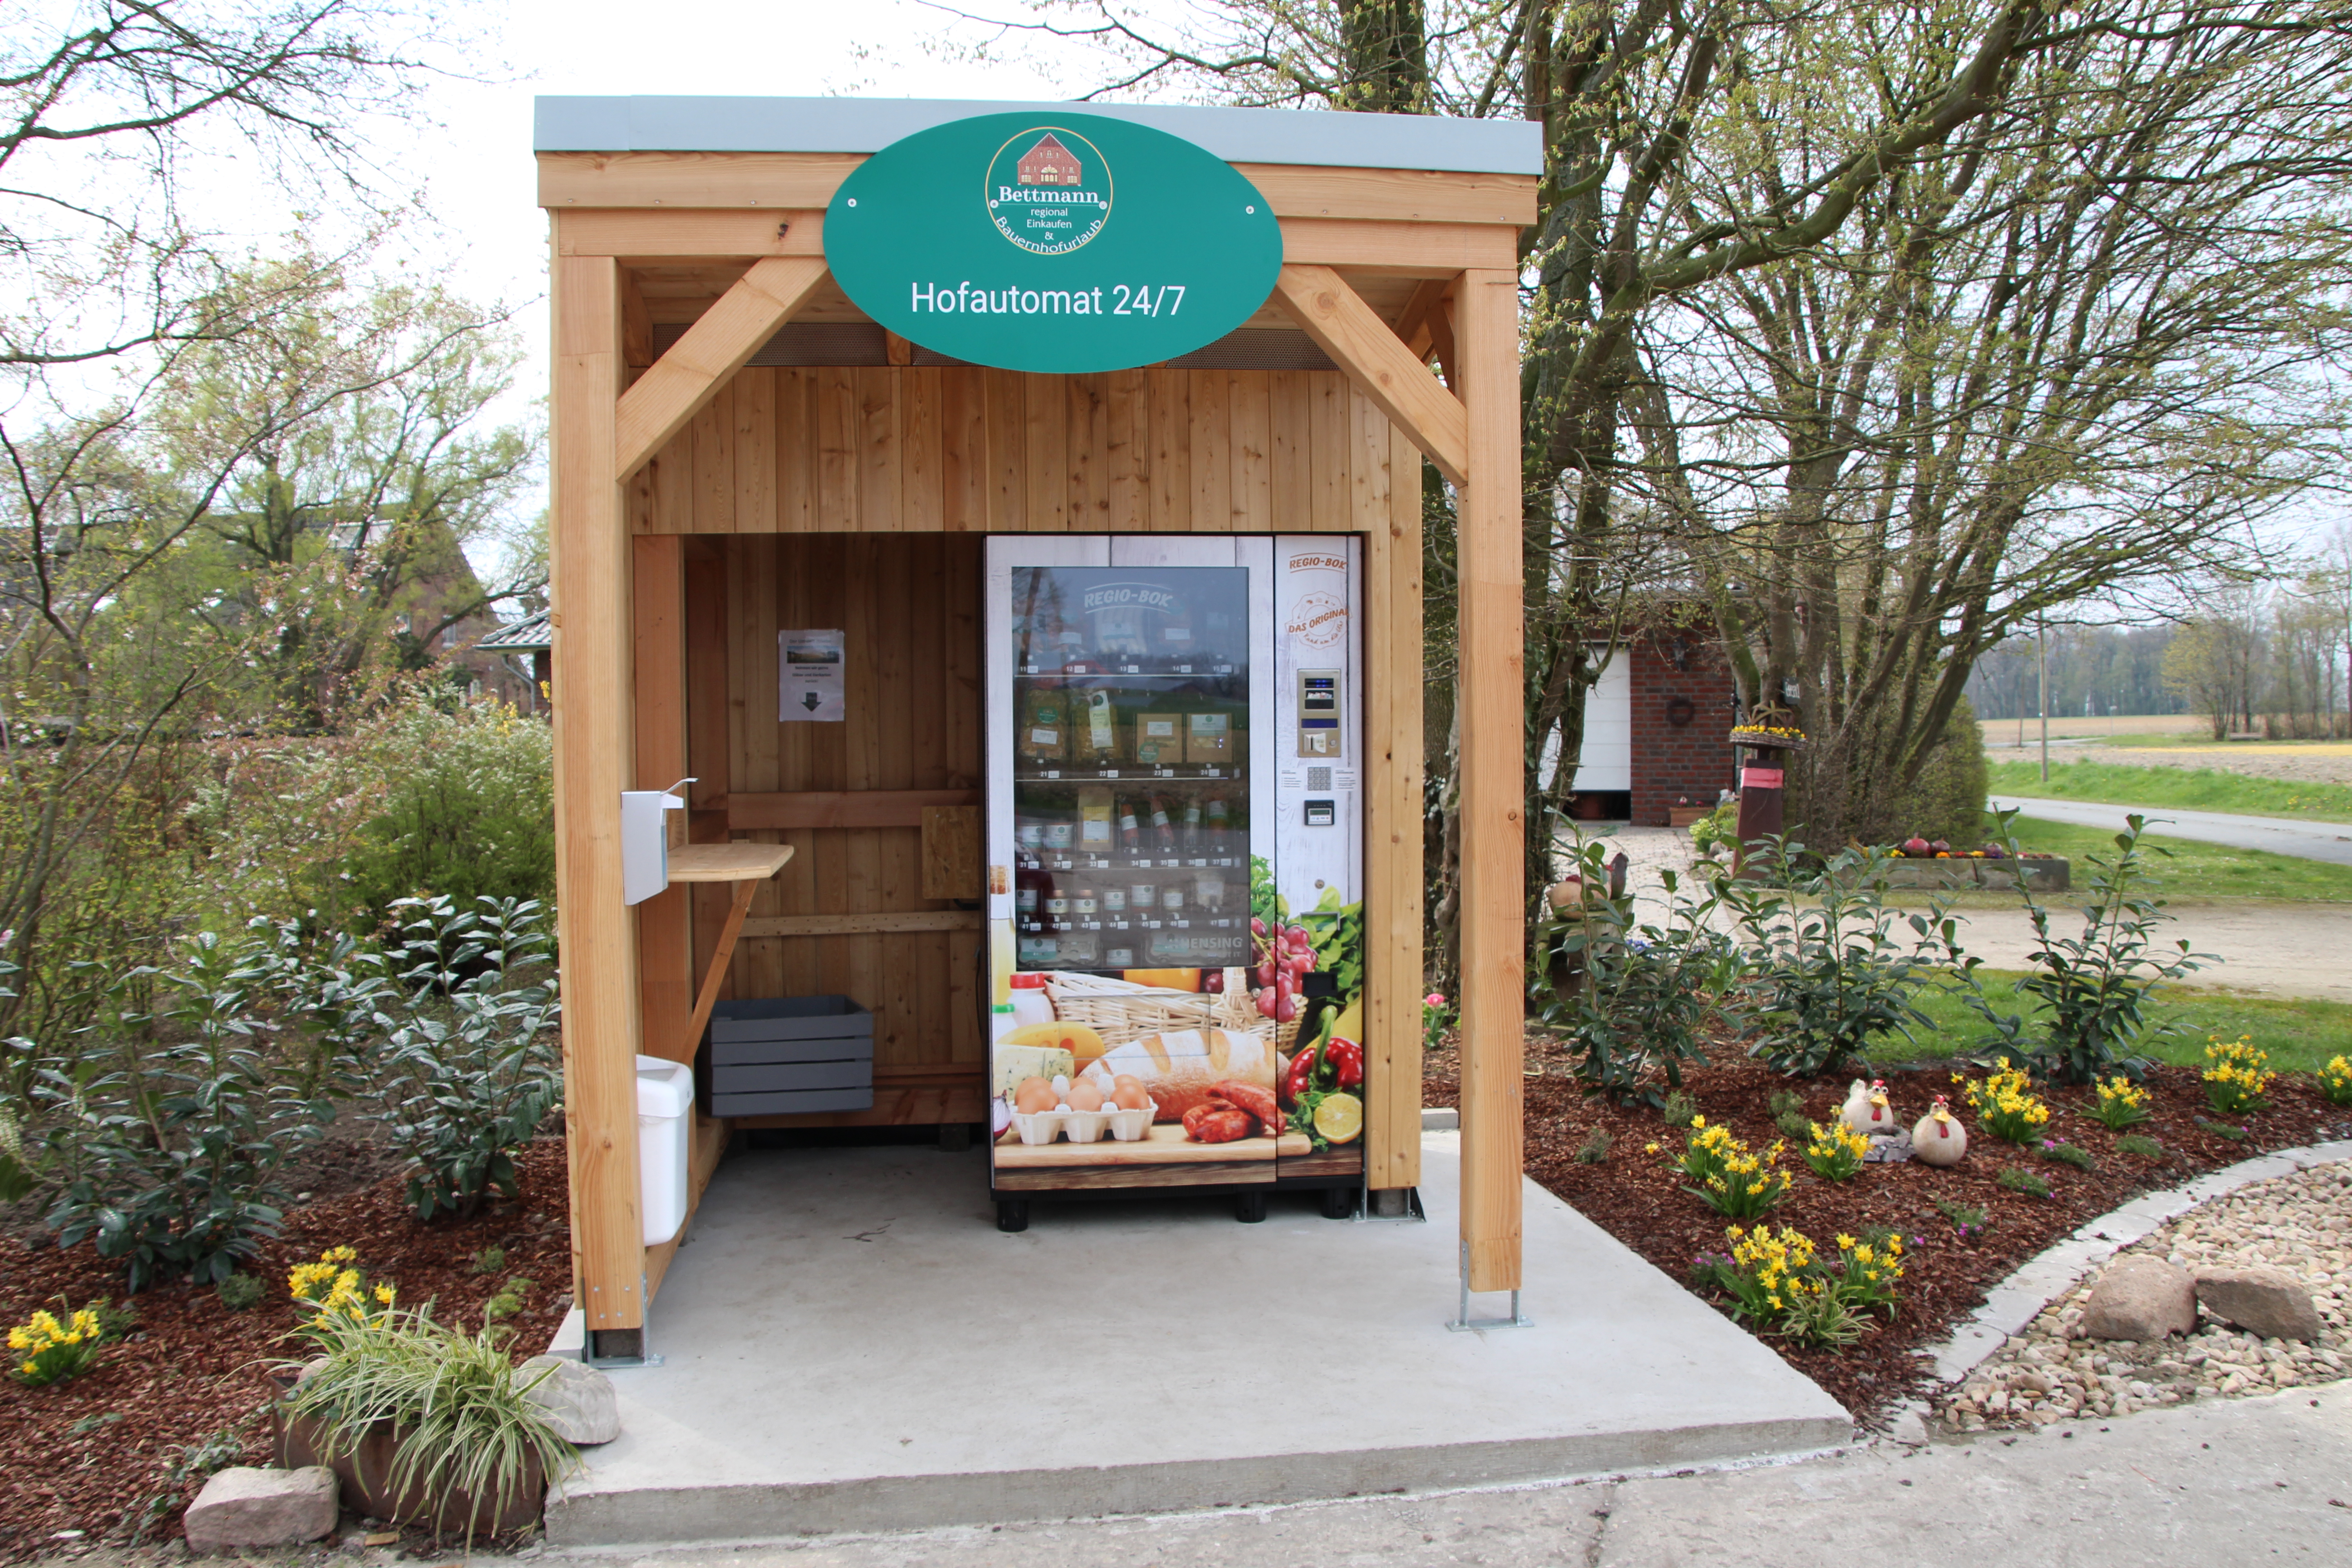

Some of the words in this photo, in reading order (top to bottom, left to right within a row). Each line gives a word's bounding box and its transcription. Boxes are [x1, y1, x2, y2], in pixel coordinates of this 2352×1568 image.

[999, 186, 1099, 203] Bettmann
[1031, 208, 1068, 218] regional
[1027, 219, 1072, 228] Einkaufen
[996, 216, 1102, 253] Bauernhofurlaub
[1044, 232, 1054, 240] &
[911, 281, 1102, 315] Hofautomat
[1112, 285, 1185, 318] 24/7
[1289, 557, 1348, 569] REGIO-BOX
[1084, 589, 1173, 608] REGIO-BOX
[1289, 623, 1307, 633] DAS
[1309, 608, 1349, 628] ORIGINAL
